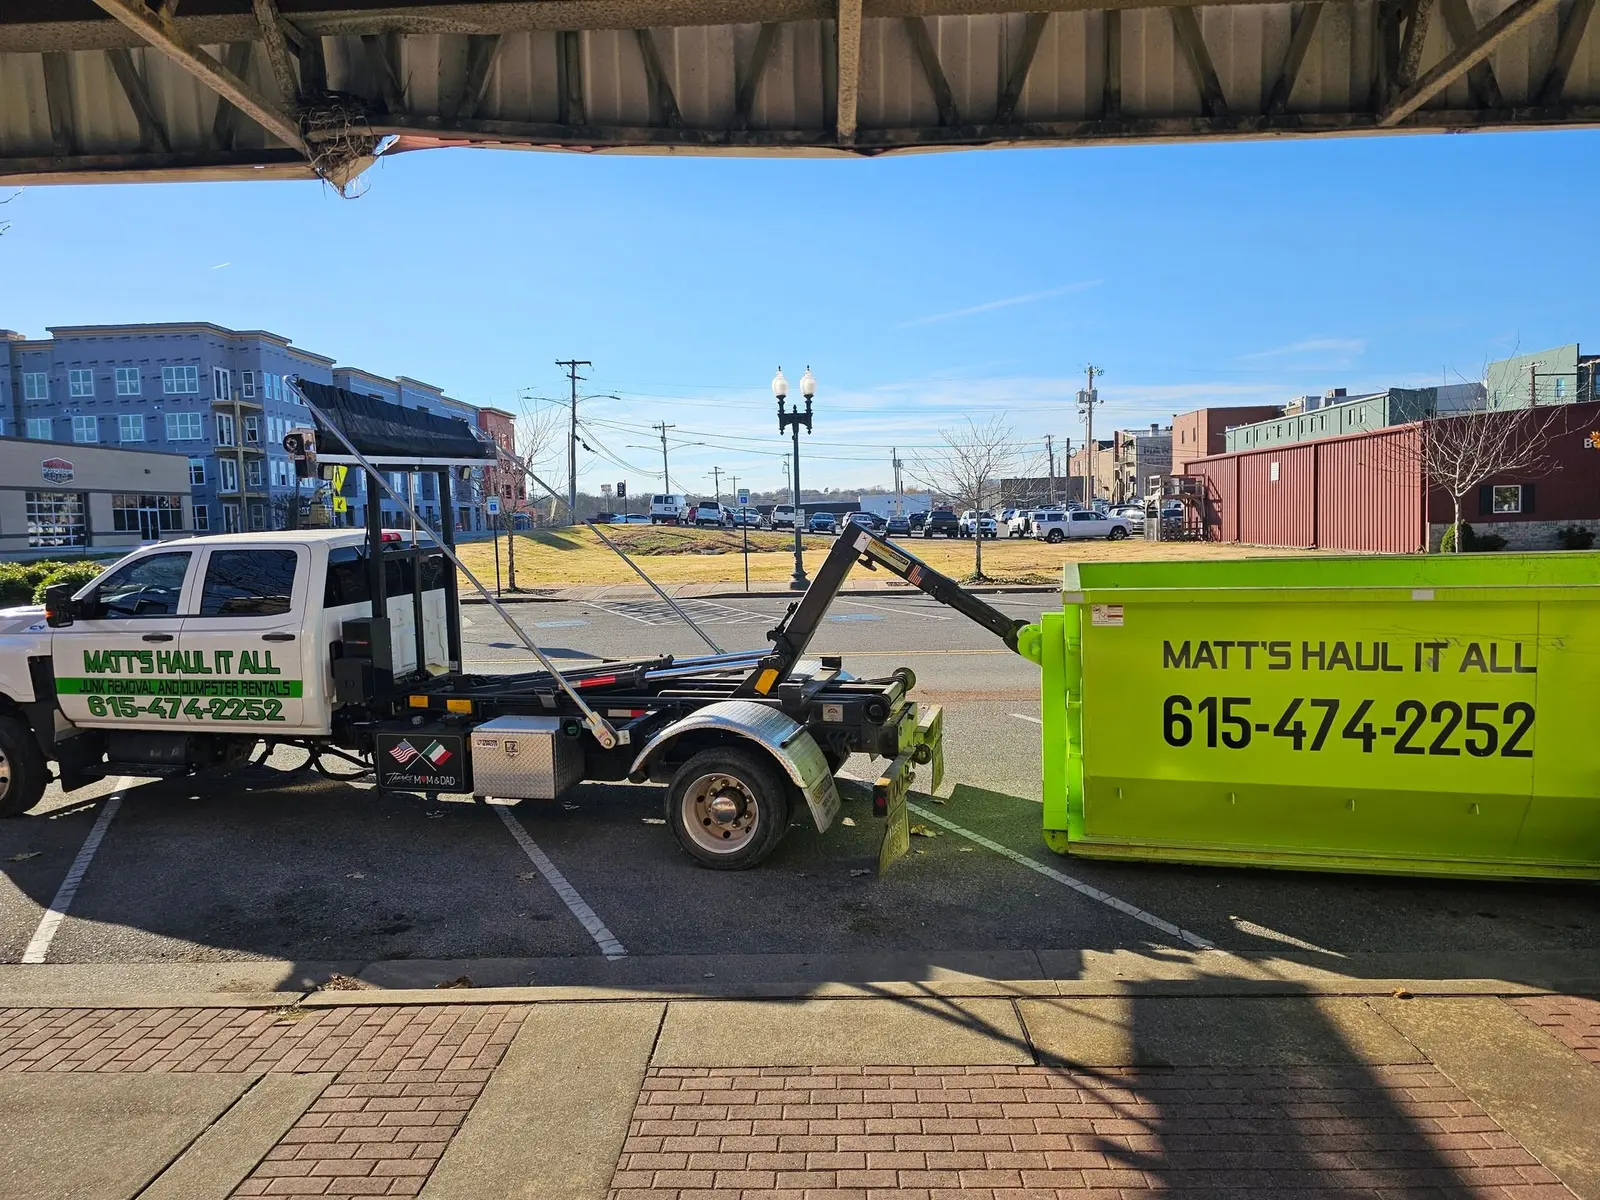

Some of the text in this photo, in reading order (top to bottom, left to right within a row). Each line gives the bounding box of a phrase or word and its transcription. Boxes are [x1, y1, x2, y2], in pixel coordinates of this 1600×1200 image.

[83, 650, 281, 674] MATT'S HAUL IT ALL
[1162, 640, 1537, 673] MATT'S HAUL IT ALL
[79, 679, 290, 696] JUNK REMOVAL AND DUMPSTER RENTALS
[87, 696, 286, 721] 615-474-2252
[1163, 694, 1536, 758] 615-474-2252
[386, 772, 413, 784] Thanks
[440, 776, 456, 786] DAD
